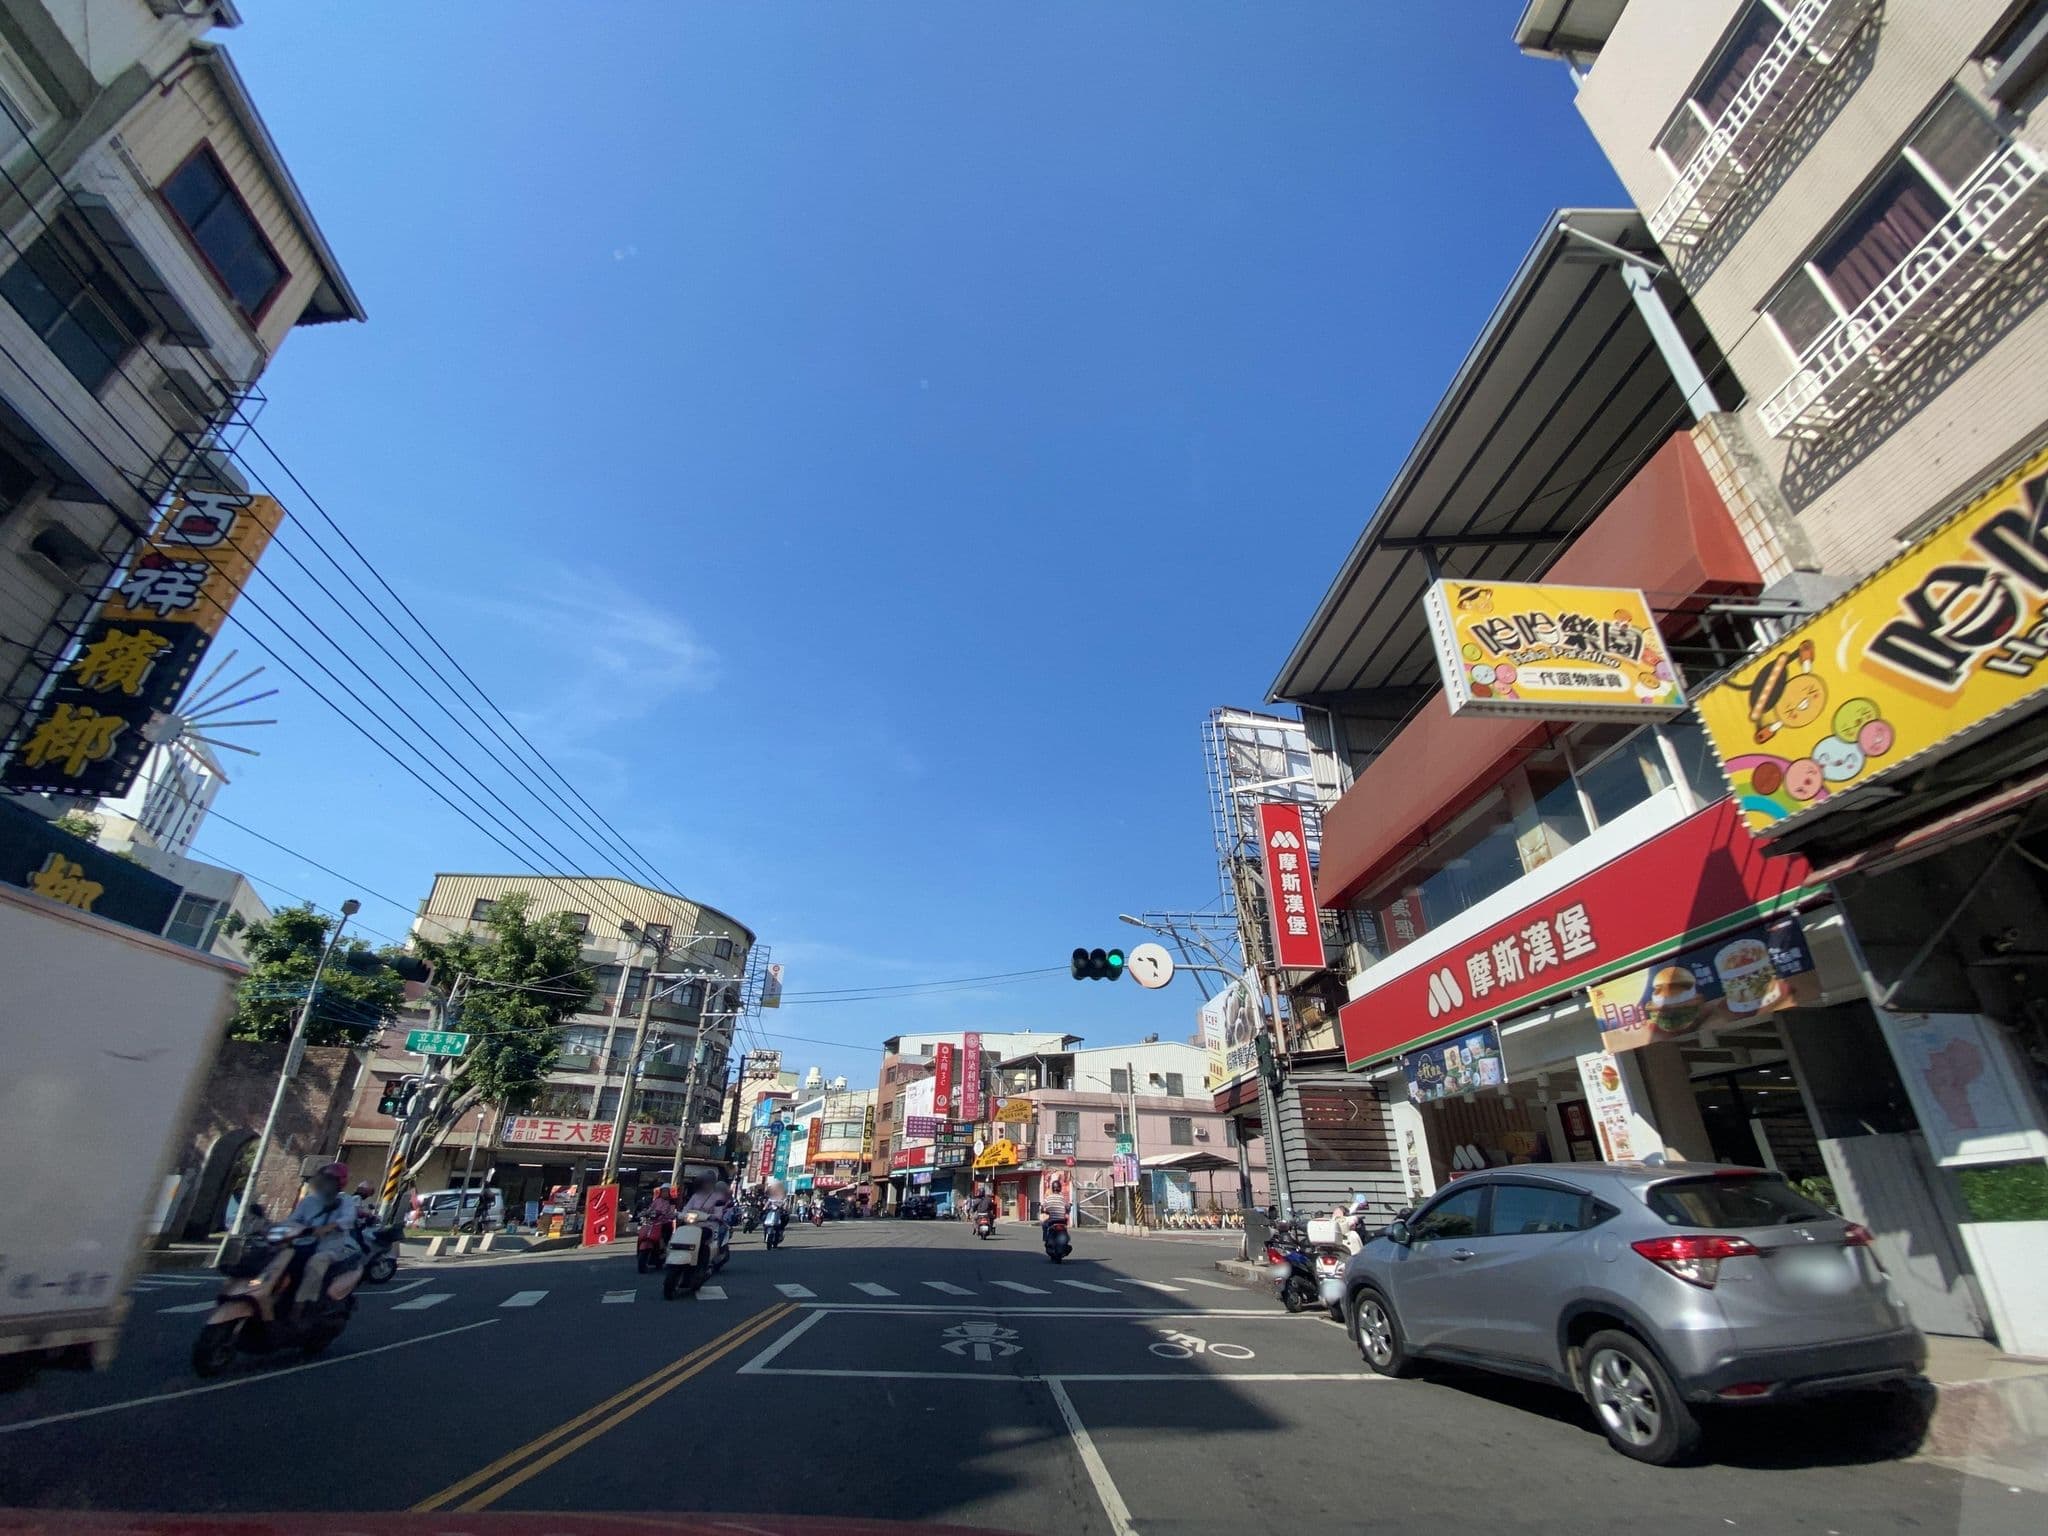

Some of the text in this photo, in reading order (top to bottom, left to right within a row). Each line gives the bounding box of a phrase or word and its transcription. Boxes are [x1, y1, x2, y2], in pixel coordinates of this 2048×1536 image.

[1470, 610, 1643, 661] 哈哈樂園
[1278, 852, 1309, 936] 摩斯漢堡
[1466, 903, 1598, 999] 摩斯漢堡
